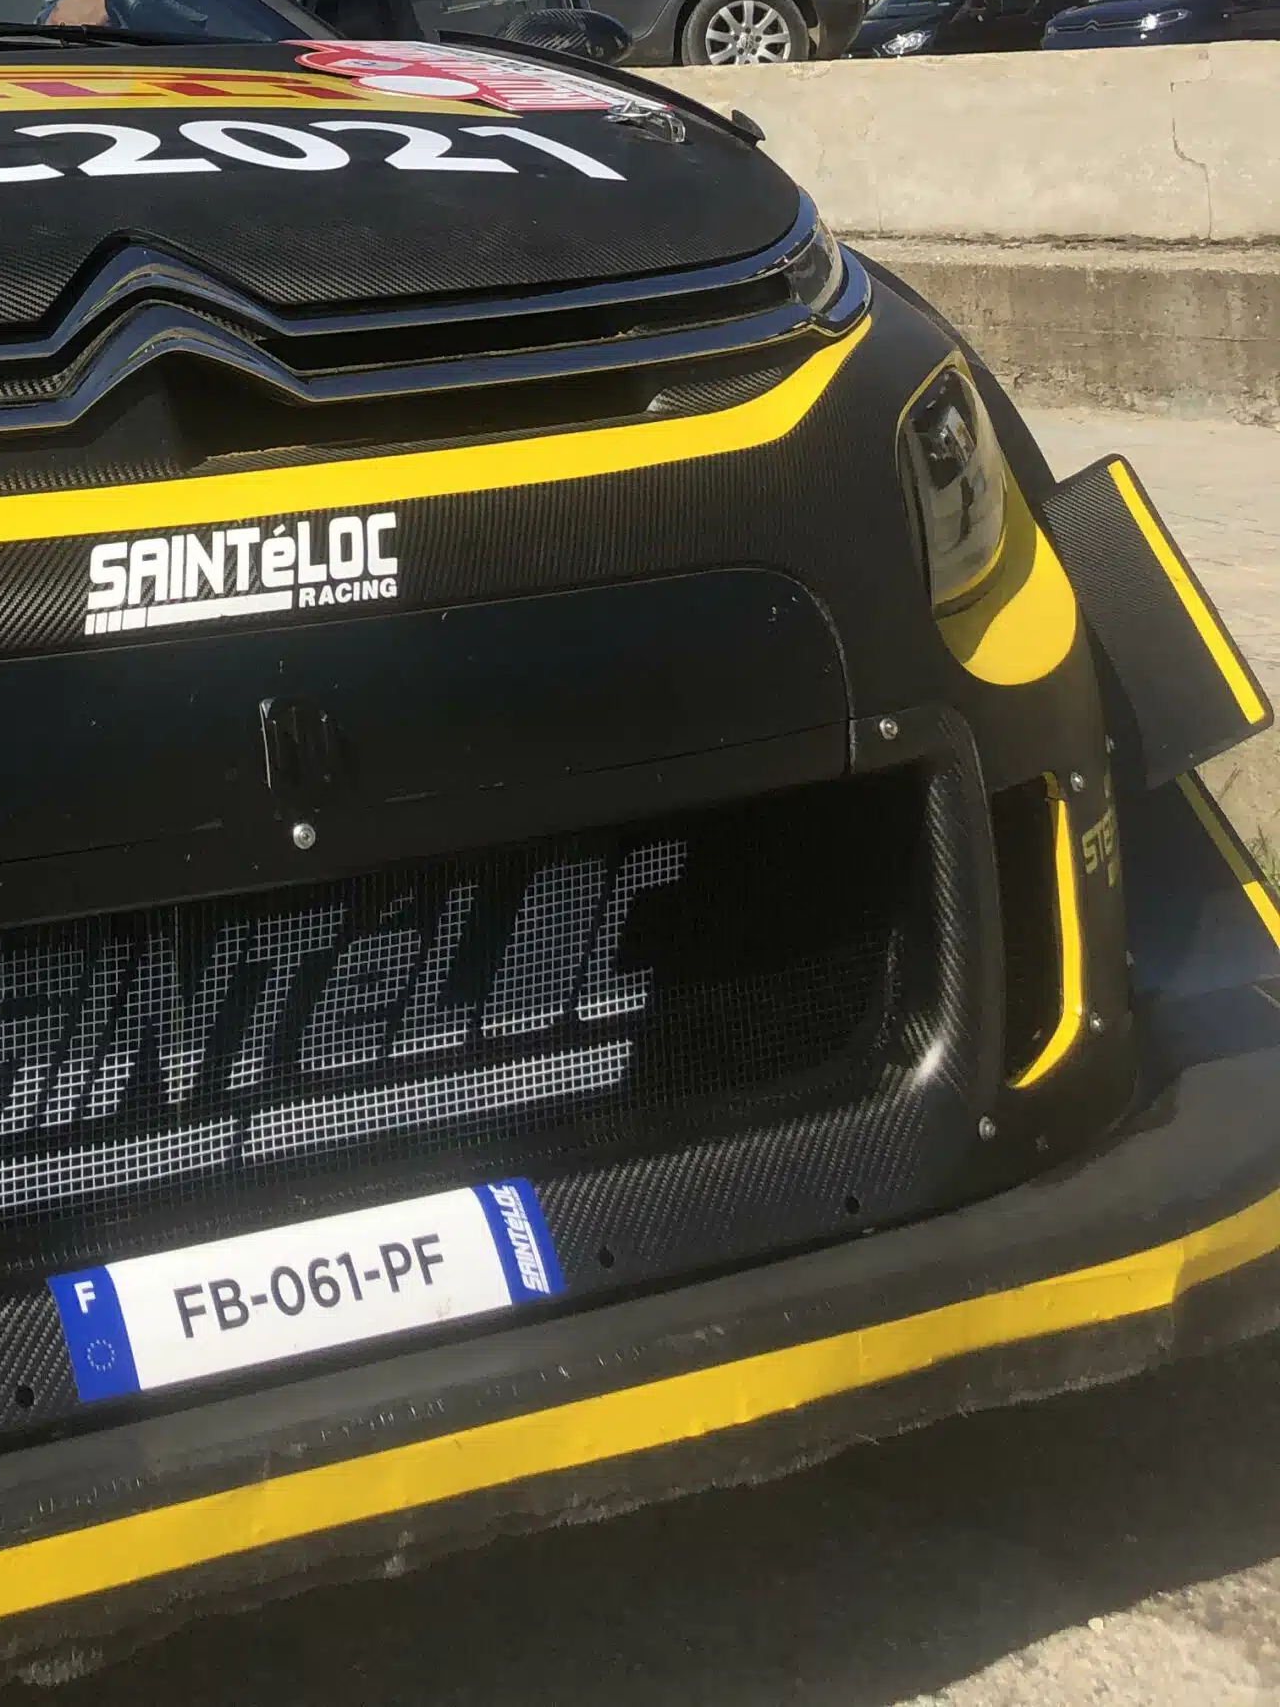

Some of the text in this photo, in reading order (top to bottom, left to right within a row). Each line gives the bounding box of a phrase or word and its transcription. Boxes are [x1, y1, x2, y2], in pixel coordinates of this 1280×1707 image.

[87, 512, 398, 610] SAINTéLOC
[298, 577, 398, 609] RACING
[74, 1233, 445, 1339] F FB-061-PF
